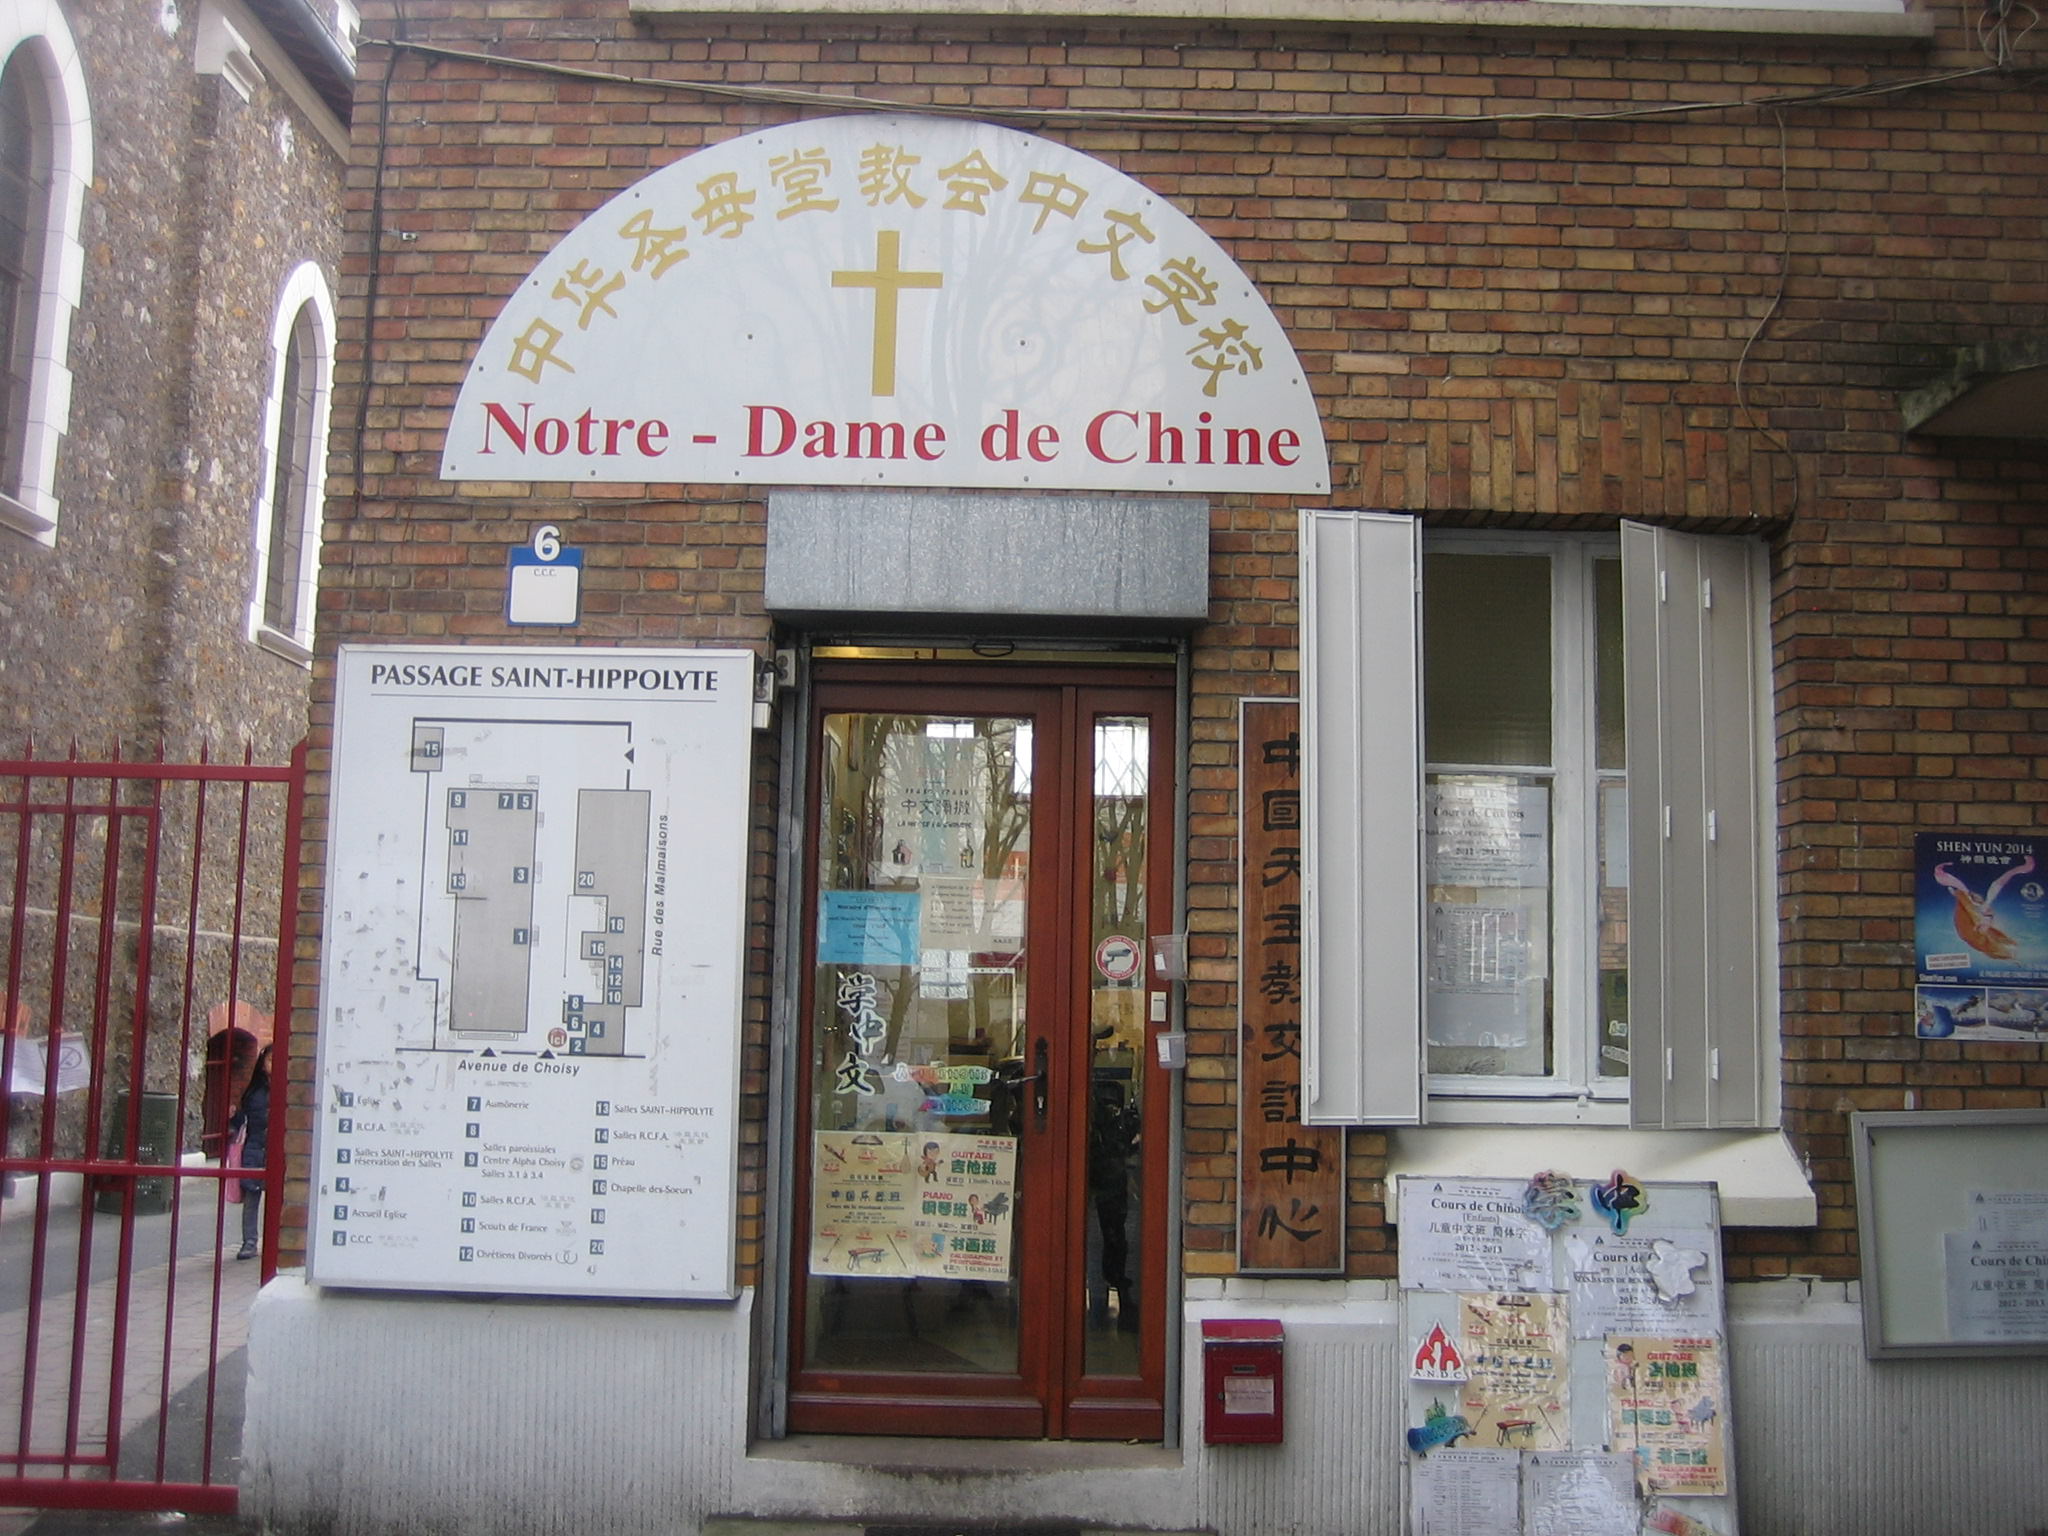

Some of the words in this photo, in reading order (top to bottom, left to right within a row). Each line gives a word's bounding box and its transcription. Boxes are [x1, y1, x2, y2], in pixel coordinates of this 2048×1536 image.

[476, 401, 669, 458] Notre
[740, 404, 946, 461] Dame
[980, 409, 1061, 462] de
[1085, 409, 1301, 466] Chine
[534, 525, 560, 562] 6
[371, 664, 482, 687] PASSAGE
[491, 666, 718, 691] SAINT-HIPPOLYTE
[425, 743, 439, 756] 15
[454, 793, 462, 806] 9
[502, 795, 510, 807] 7
[522, 797, 530, 808] 5
[454, 832, 466, 843] 11
[1936, 840, 1971, 852] SHEN
[1975, 842, 2002, 853] YUN
[2005, 843, 2033, 855] 2014
[654, 815, 668, 896] Malmaisons
[452, 875, 465, 887] 13
[517, 869, 525, 881] 3
[579, 873, 594, 886] 20
[653, 900, 664, 925] des
[610, 918, 623, 931] 18
[651, 929, 663, 956] Rue
[591, 943, 604, 955] 16
[609, 957, 622, 969] 14
[609, 974, 622, 986] 12
[571, 997, 579, 1009] 8
[608, 991, 621, 1003] 10
[571, 1017, 579, 1029] 6
[593, 1023, 601, 1035] 4
[574, 1040, 582, 1052] 2
[458, 1060, 507, 1072] Avenue
[512, 1062, 528, 1073] de
[534, 1062, 580, 1076] Choisy
[597, 1102, 609, 1113] 13
[614, 1104, 638, 1113] Salles
[640, 1105, 714, 1116] SAINT-HIPPOLYTE
[613, 1130, 637, 1140] Salles
[355, 1148, 378, 1157] Salles
[381, 1149, 454, 1160] SAINT-HIPPOLYTE
[483, 1143, 506, 1152] Salles
[509, 1144, 556, 1154] paroissiales
[951, 1151, 994, 1160] GUITARE
[401, 1159, 416, 1167] des
[483, 1156, 510, 1165] Centre
[512, 1156, 536, 1167] Alpha
[538, 1157, 566, 1168] Choisy
[595, 1157, 607, 1168] 15
[481, 1169, 505, 1178] Salles
[594, 1182, 607, 1193] 16
[611, 1183, 647, 1194] Chapelle
[463, 1194, 476, 1205] 10
[480, 1195, 504, 1204] Salles
[923, 1191, 953, 1200] PIANO
[1431, 1198, 1466, 1210] Cours
[1469, 1201, 1482, 1211] de
[352, 1209, 382, 1218] Accueil
[593, 1210, 605, 1222] 18
[462, 1220, 474, 1232] 11
[479, 1222, 506, 1231] Scouts
[508, 1222, 518, 1232] de
[521, 1224, 548, 1233] France
[1455, 1243, 1474, 1252] 2012
[461, 1249, 473, 1260] 12
[1593, 1252, 1628, 1263] Cours
[1970, 1255, 2006, 1266] Cours
